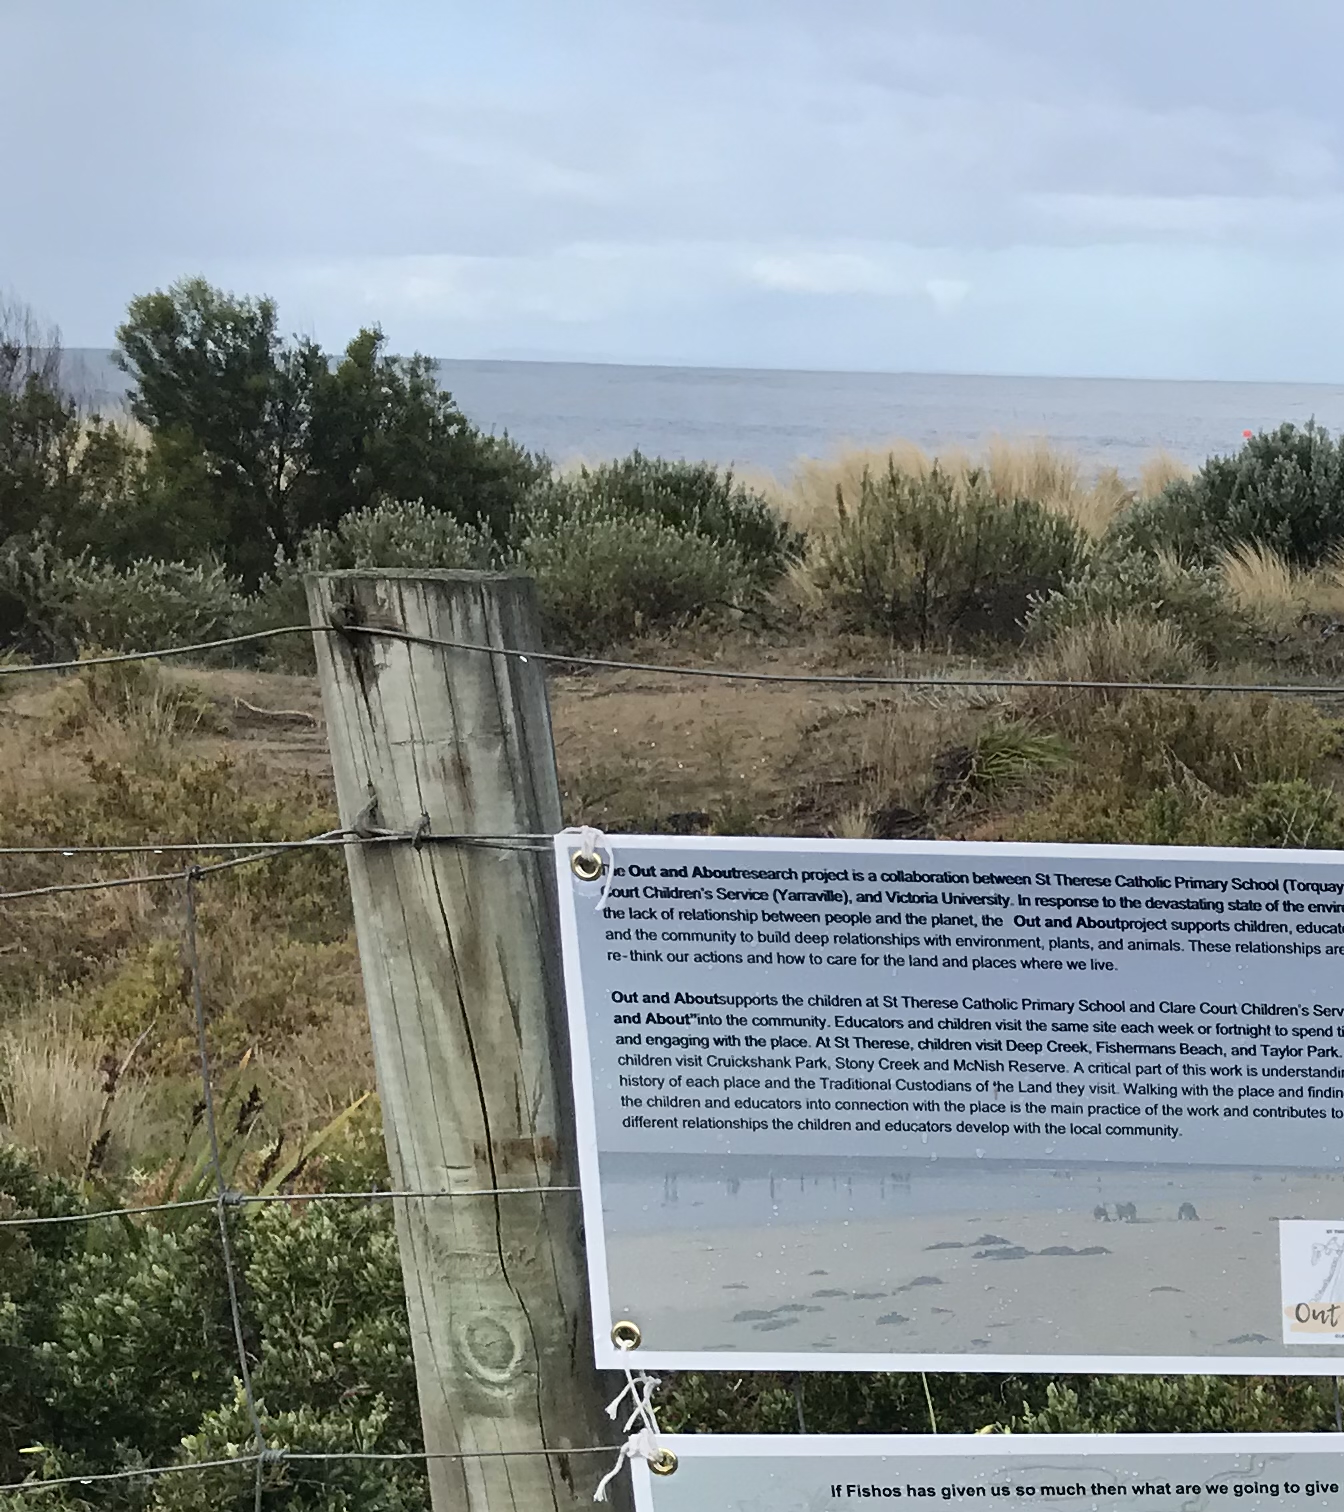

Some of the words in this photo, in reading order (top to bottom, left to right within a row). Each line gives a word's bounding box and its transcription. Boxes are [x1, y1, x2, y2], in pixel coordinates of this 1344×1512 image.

[605, 928, 631, 940] and
[634, 928, 657, 940] the
[661, 930, 736, 945] community
[739, 931, 753, 942] to
[757, 930, 790, 943] build
[794, 932, 829, 947] deep
[833, 932, 920, 948] relationships
[923, 934, 951, 946] with
[955, 935, 1044, 950] environment,
[1048, 936, 1093, 951] plants,
[1097, 938, 1123, 950] and
[1127, 938, 1184, 952] animals.
[1187, 939, 1231, 952] These
[1235, 941, 1321, 957] relationships
[617, 1054, 671, 1066] children
[675, 1054, 703, 1067] visit
[706, 1055, 791, 1068] Cruickshank
[795, 1056, 830, 1070] Park,
[835, 1057, 874, 1073] Stony
[878, 1057, 919, 1070] Creek
[923, 1058, 949, 1071] and
[953, 1058, 1004, 1072] McNish
[1008, 1059, 1068, 1073] Reserve.
[1073, 1062, 1084, 1073] A
[1087, 1062, 1131, 1074] critical
[1135, 1063, 1162, 1077] part
[1165, 1062, 1178, 1075] of
[1182, 1064, 1206, 1075] this
[1209, 1065, 1242, 1076] work
[1246, 1065, 1258, 1076] is
[621, 1116, 678, 1128] different
[682, 1116, 768, 1131] relationships
[771, 1118, 793, 1130] the
[797, 1118, 851, 1130] children
[855, 1119, 880, 1131] and
[884, 1120, 952, 1132] educators
[955, 1121, 1009, 1136] develop
[1013, 1122, 1040, 1134] with
[1044, 1122, 1066, 1134] the
[1069, 1123, 1101, 1135] local
[1105, 1125, 1182, 1139] community.
[1295, 1302, 1340, 1327] Out
[830, 1484, 841, 1497] If
[846, 1484, 901, 1497] Fishos
[906, 1484, 936, 1497] has
[941, 1484, 985, 1499] given
[990, 1485, 1010, 1496] us
[1015, 1485, 1035, 1496] so
[1040, 1483, 1086, 1496] much
[1090, 1483, 1126, 1495] then
[1131, 1482, 1171, 1495] what
[1175, 1484, 1201, 1494] are
[1205, 1484, 1228, 1494] we
[1233, 1482, 1279, 1496] going
[1283, 1481, 1300, 1493] to
[1305, 1481, 1338, 1496] give
